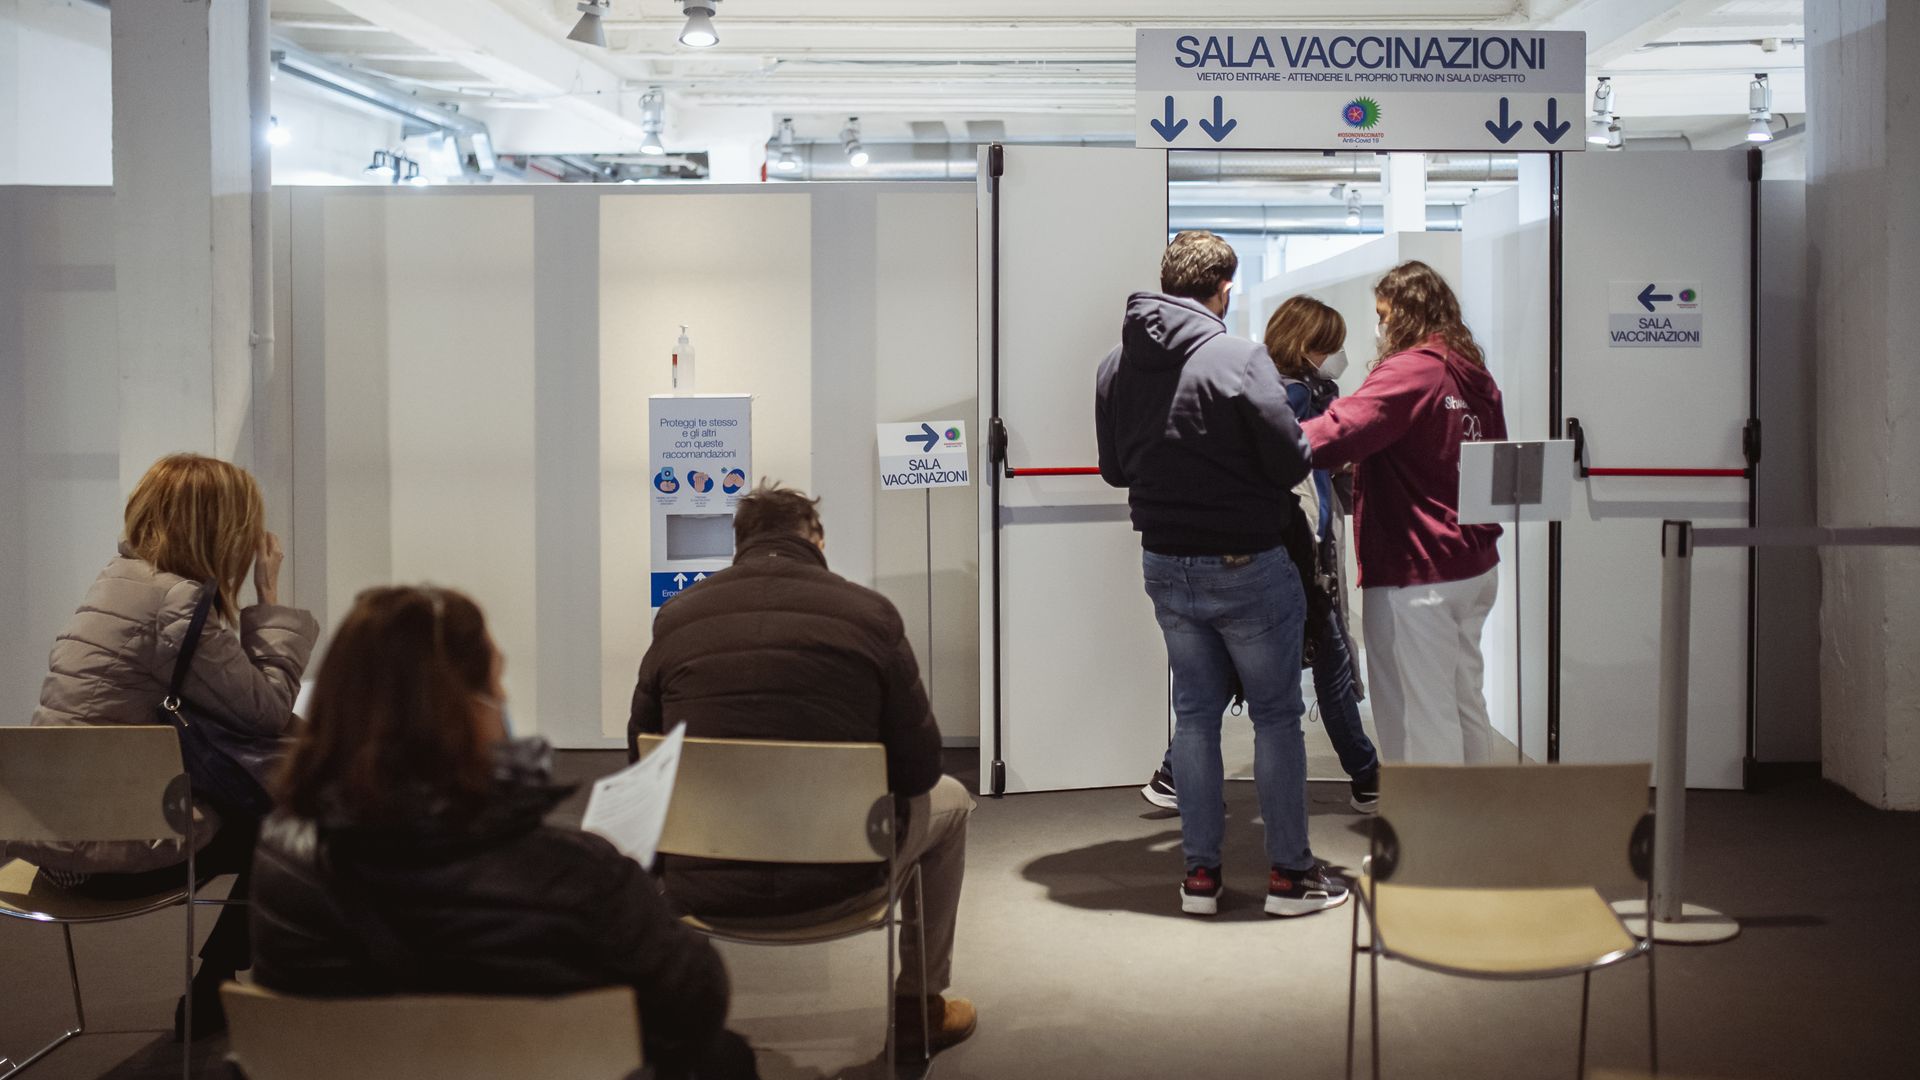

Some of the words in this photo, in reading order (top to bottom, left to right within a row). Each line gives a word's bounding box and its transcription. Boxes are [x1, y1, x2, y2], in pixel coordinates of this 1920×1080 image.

[1174, 35, 1275, 68] SALA
[1280, 35, 1546, 70] VACCINAZIONI
[1196, 72, 1235, 82] VIETATO
[1236, 72, 1281, 82] ENTRARE
[1287, 73, 1344, 82] ATTENDERE
[1345, 73, 1353, 82] IL
[1354, 73, 1398, 82] PROPRIO
[1399, 73, 1434, 83] TURNO
[1435, 74, 1445, 82] IN
[1446, 74, 1472, 82] SALA
[1473, 74, 1526, 83] D'ASPETTO
[1638, 317, 1673, 330] SALA
[1610, 330, 1700, 342] VACCINAZIONI
[660, 418, 697, 429] Proteggi
[698, 419, 708, 427] te
[709, 419, 738, 427] stesso
[690, 429, 700, 439] gli
[701, 429, 717, 437] altri
[674, 440, 692, 448] con
[693, 440, 724, 449] queste
[662, 449, 737, 459] raccomandazioni
[908, 458, 942, 471] SALA
[882, 470, 968, 486] VACCINAZIONI
